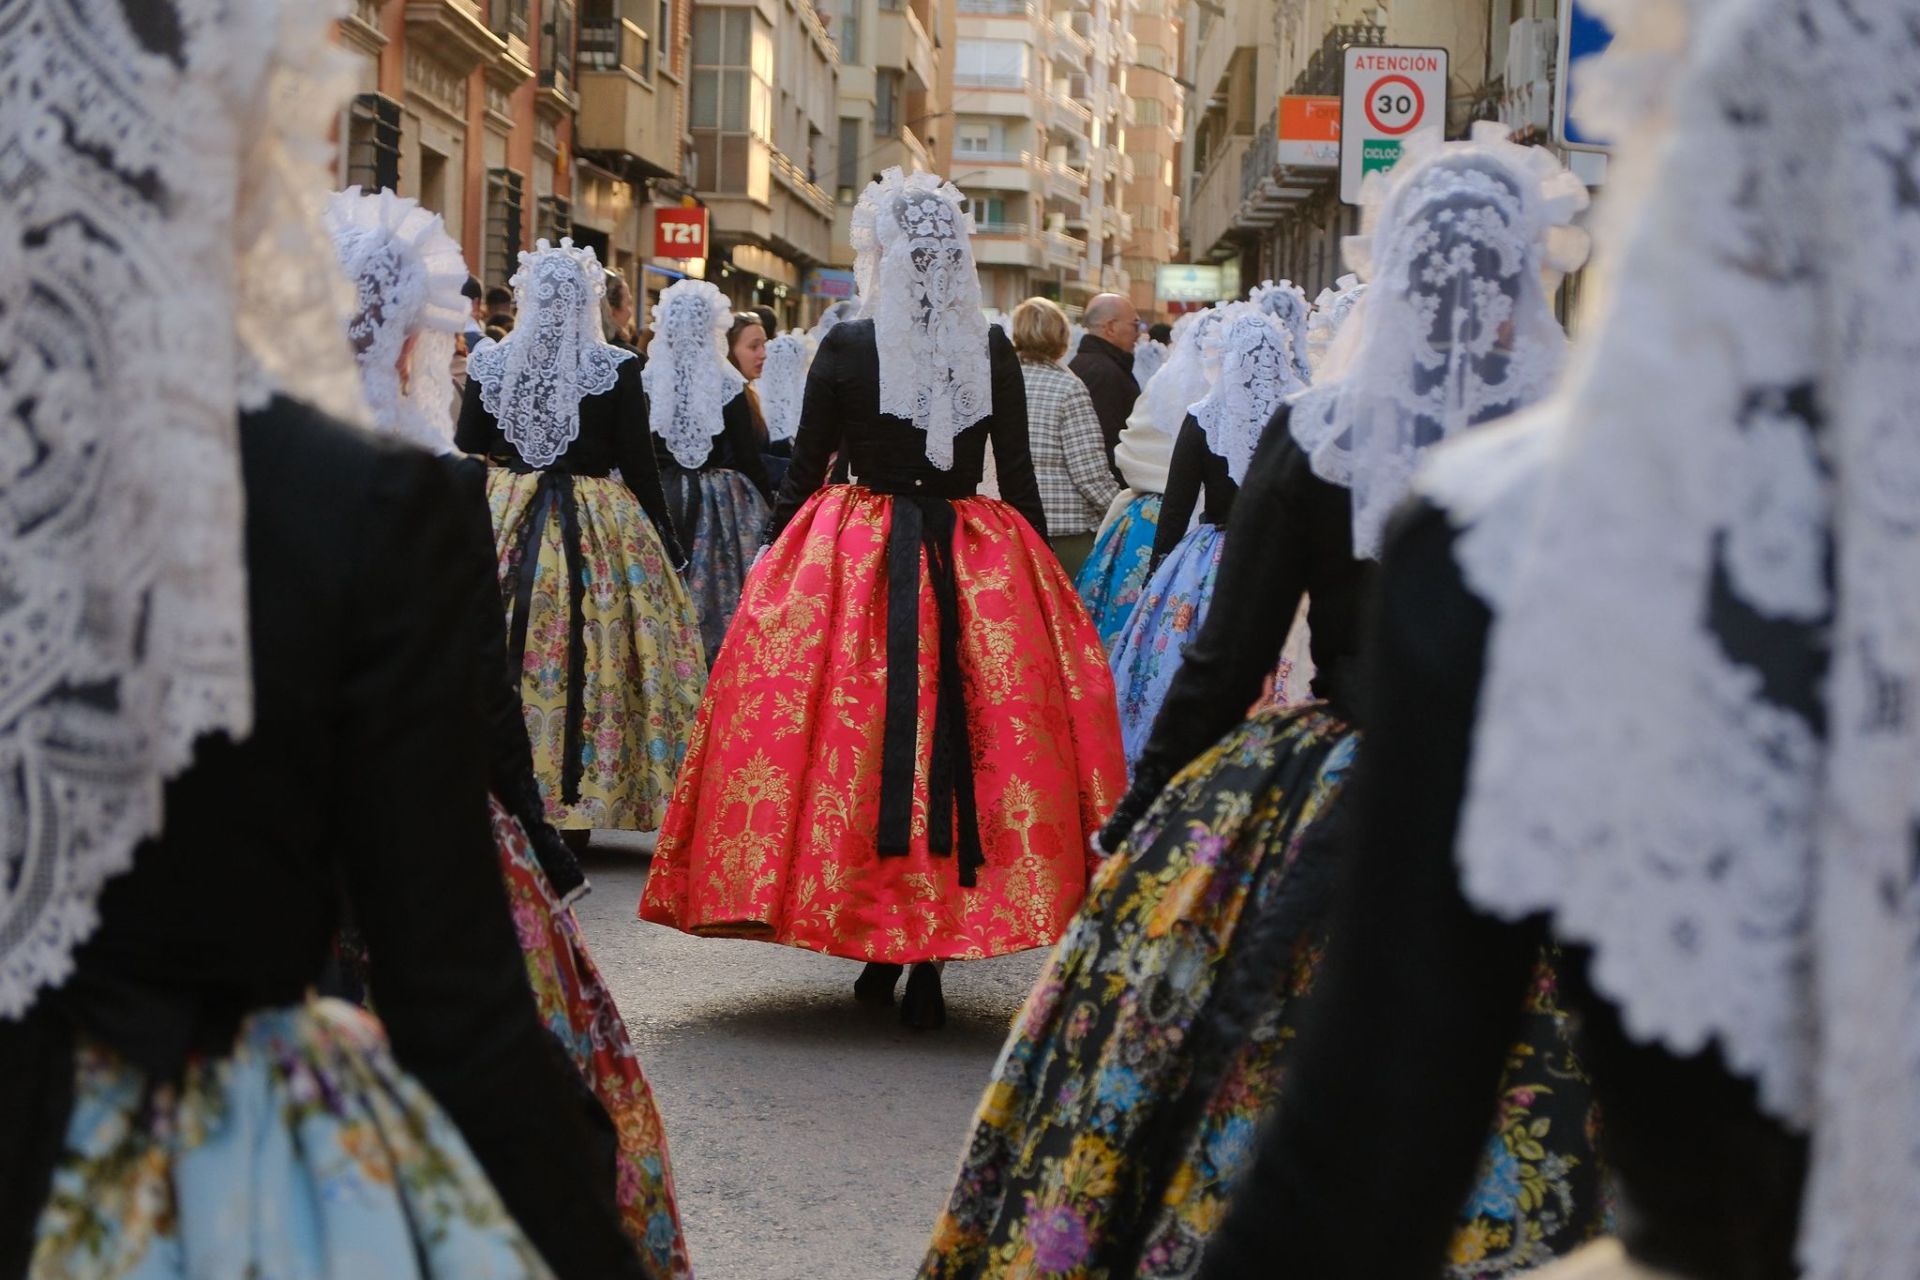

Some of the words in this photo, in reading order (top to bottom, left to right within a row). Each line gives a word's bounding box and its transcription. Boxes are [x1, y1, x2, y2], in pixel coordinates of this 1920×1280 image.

[1355, 54, 1438, 71] ATENCIÓN
[1378, 95, 1411, 114] 30
[1364, 147, 1399, 160] CICLOC
[661, 222, 702, 244] T21
